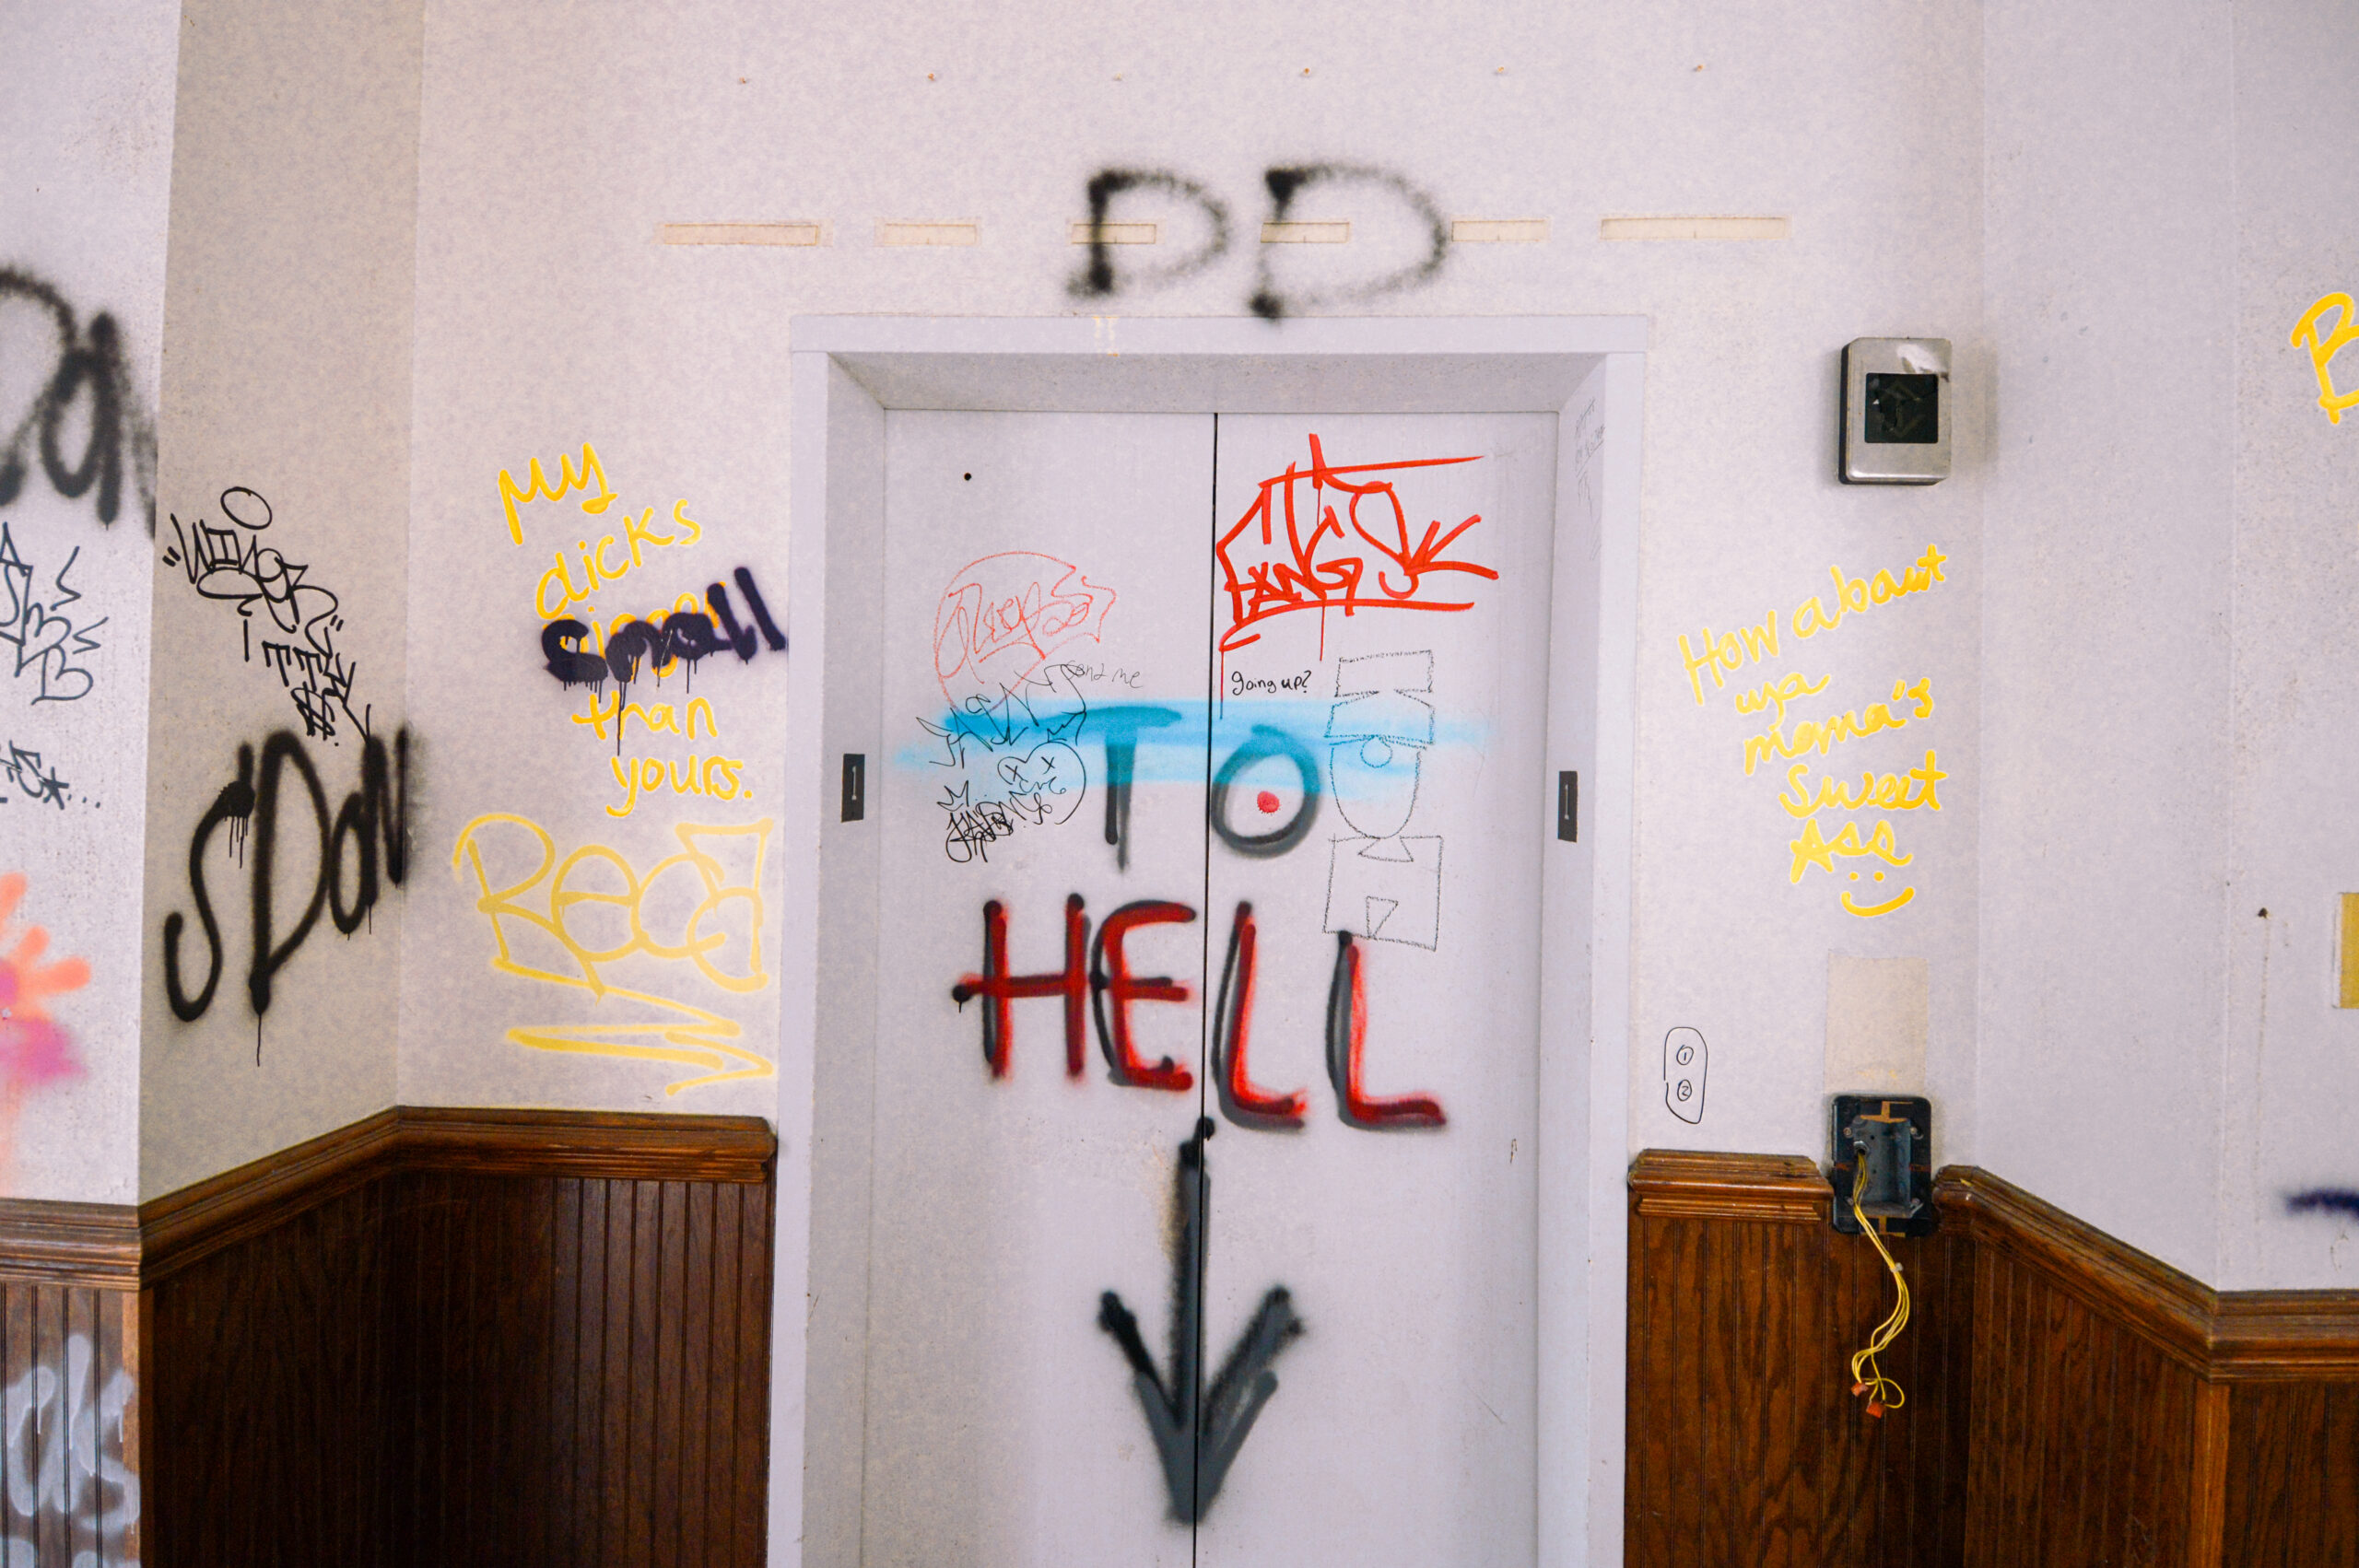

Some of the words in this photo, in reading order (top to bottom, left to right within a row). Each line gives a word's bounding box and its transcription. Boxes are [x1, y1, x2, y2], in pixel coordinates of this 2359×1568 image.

[499, 442, 618, 544] My
[1281, 670, 1312, 694] up?
[1678, 610, 1779, 706] How
[571, 690, 719, 740] than
[945, 706, 1321, 873] TO
[952, 892, 1447, 1131] HELL
